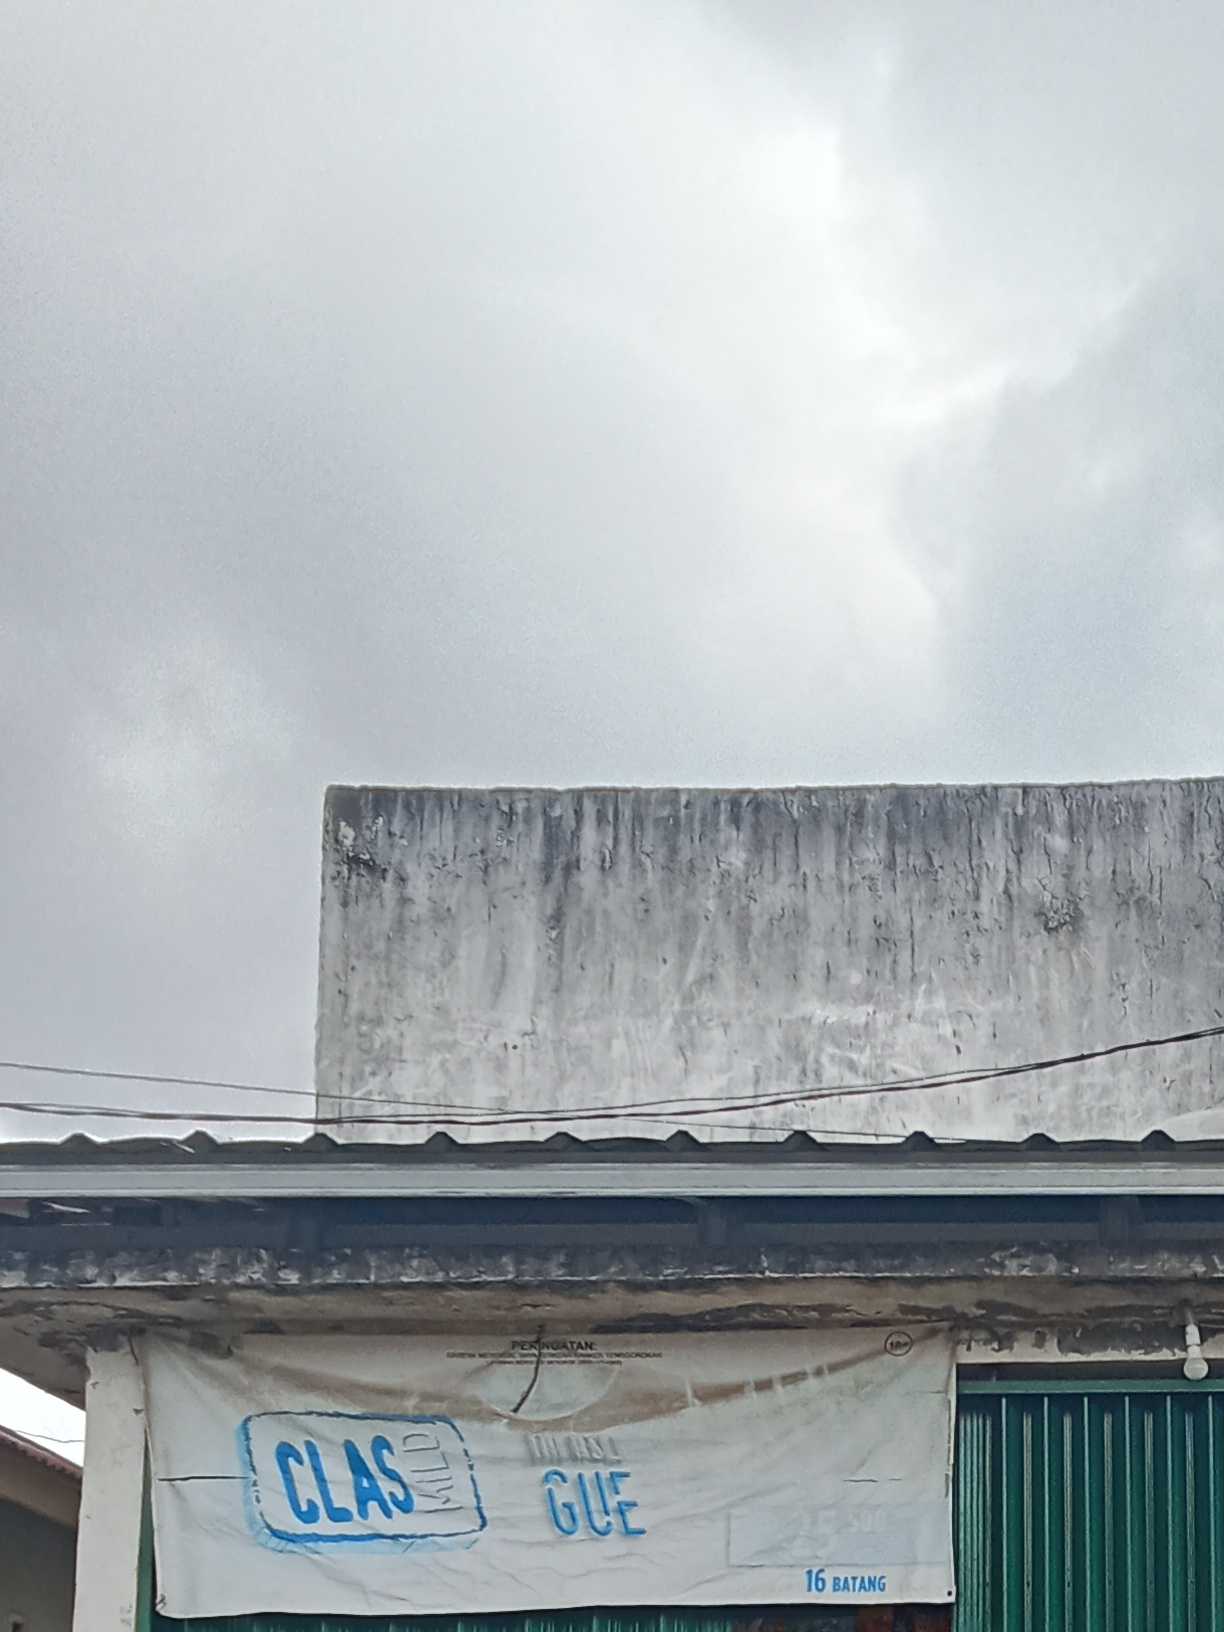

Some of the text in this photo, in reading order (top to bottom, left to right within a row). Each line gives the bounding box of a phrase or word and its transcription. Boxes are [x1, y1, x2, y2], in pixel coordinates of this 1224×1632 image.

[275, 1435, 416, 1525] CLAS
[402, 1433, 464, 1514] MILD
[543, 1468, 647, 1537] GUE
[806, 1568, 887, 1593] 16 BATANG
